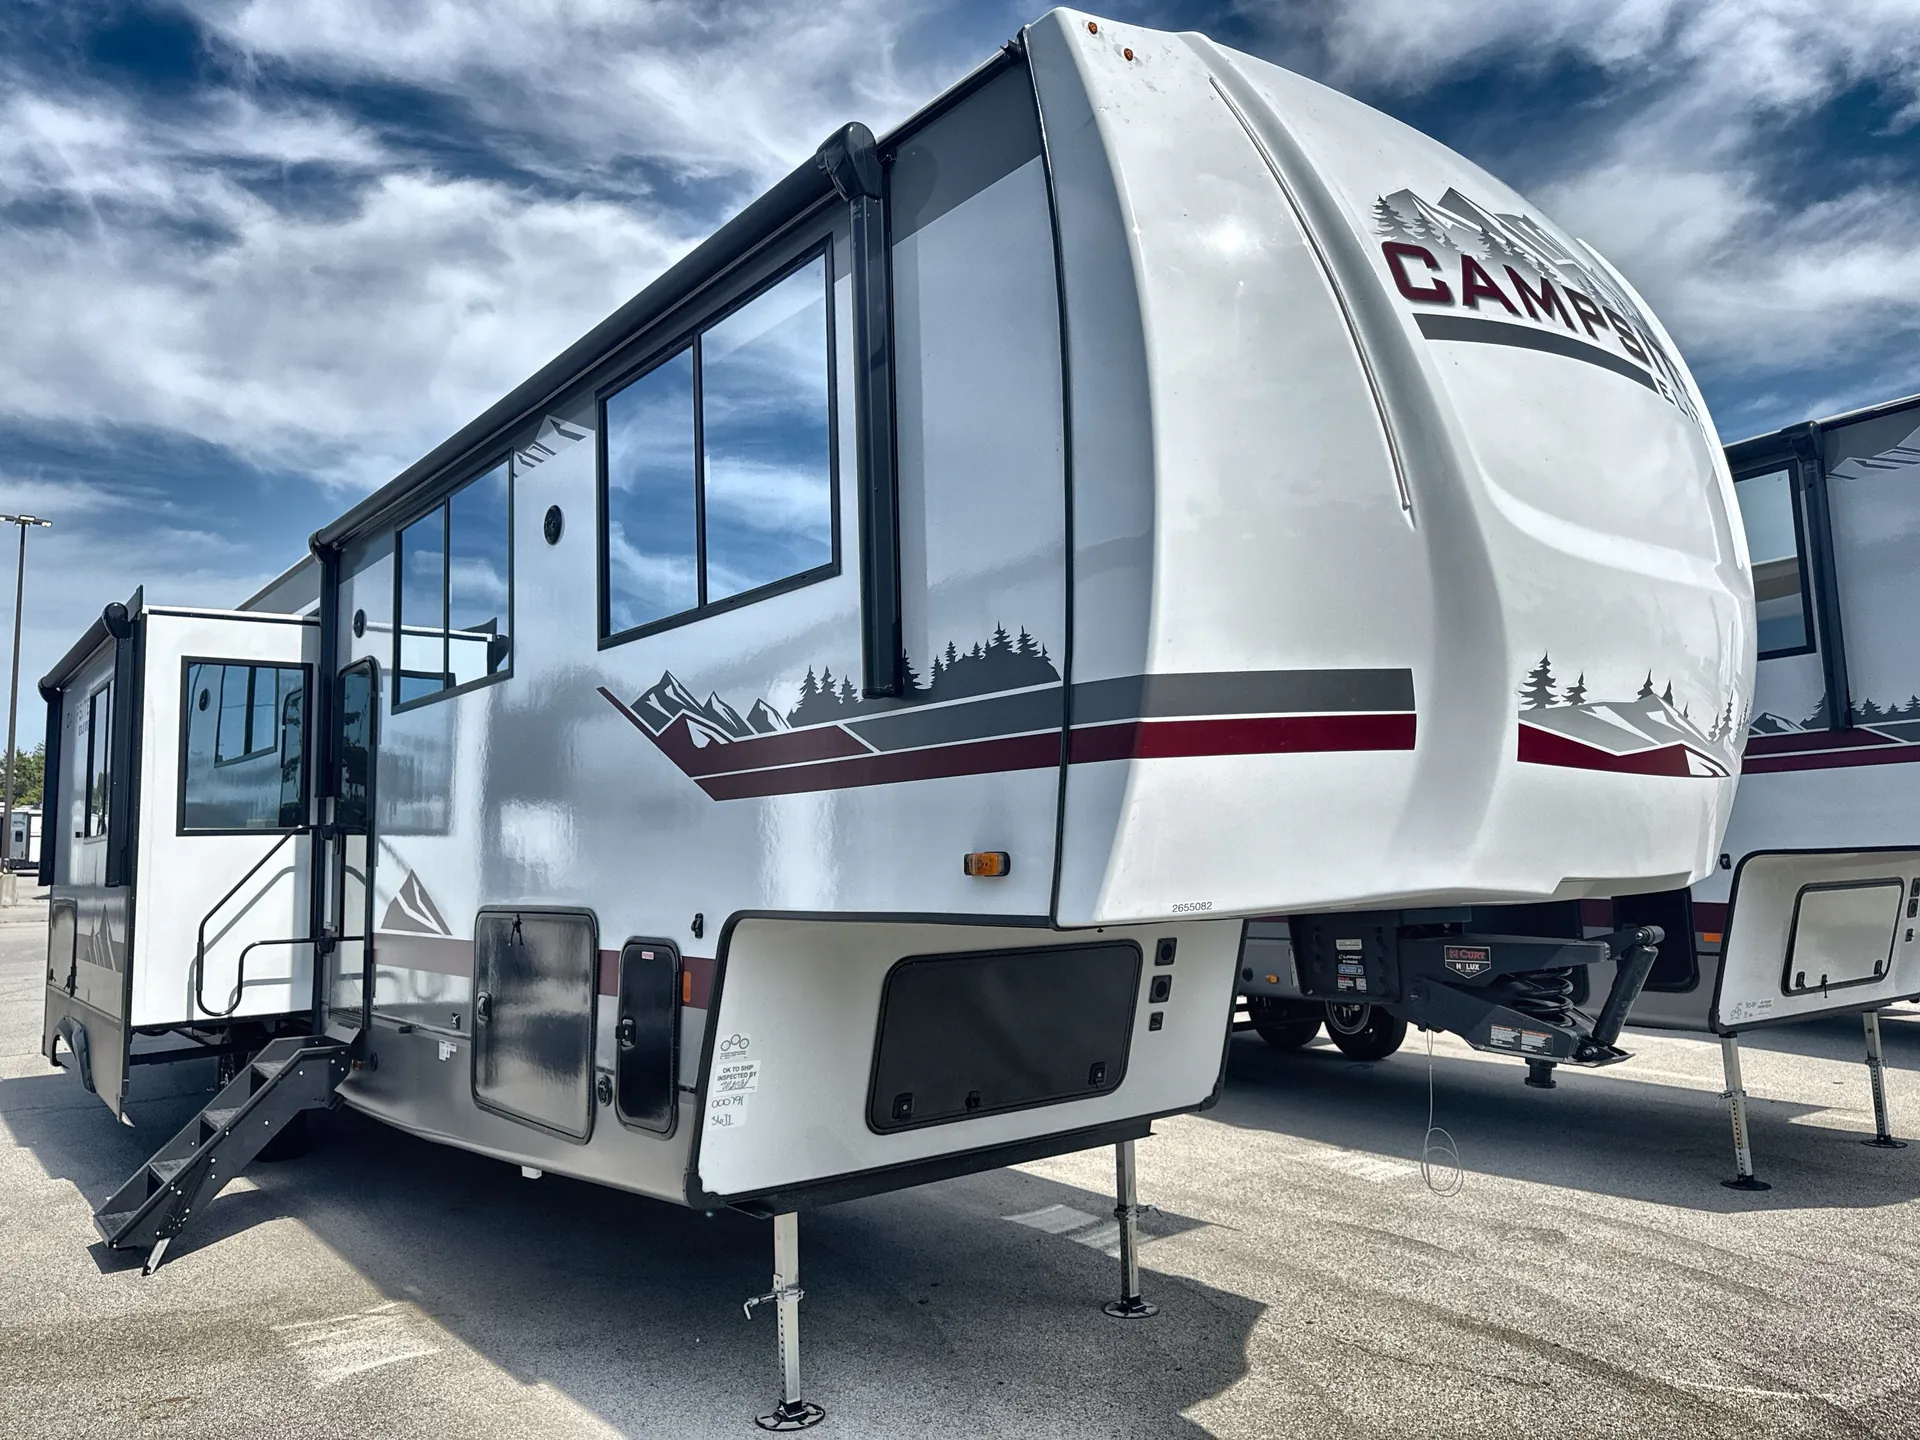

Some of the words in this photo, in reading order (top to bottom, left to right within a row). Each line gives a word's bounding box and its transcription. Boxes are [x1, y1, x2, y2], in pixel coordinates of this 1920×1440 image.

[1172, 901, 1213, 913] 2655082
[1460, 950, 1486, 960] CURT
[740, 1064, 754, 1072] SHIP
[717, 1072, 748, 1081] INSPECTED
